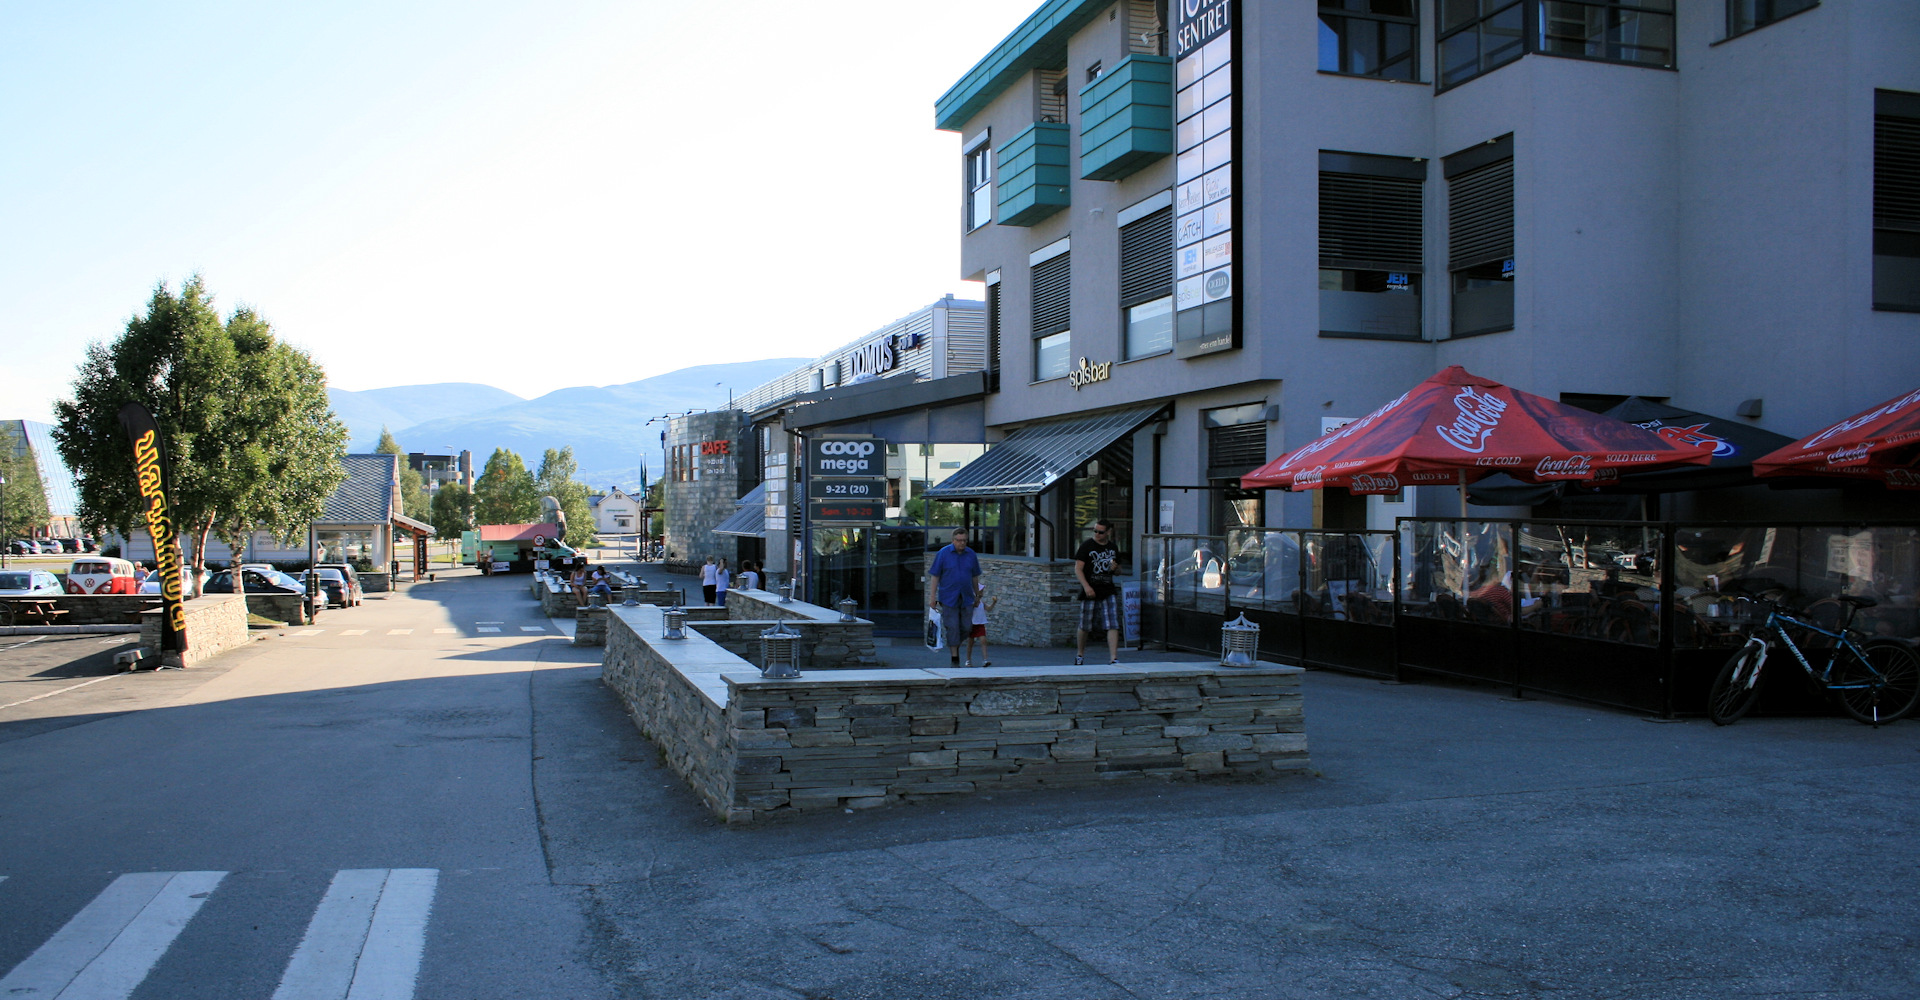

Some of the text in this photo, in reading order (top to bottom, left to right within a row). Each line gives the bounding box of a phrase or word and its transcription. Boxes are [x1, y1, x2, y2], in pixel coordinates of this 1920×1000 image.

[1178, 0, 1230, 55] SENTRET
[1178, 221, 1201, 242] CATCH
[1387, 273, 1408, 284] JEH
[849, 335, 893, 380] DOMUS
[1070, 357, 1111, 391] spisbar
[701, 440, 731, 455] CAFE
[820, 442, 875, 458] coop
[1475, 457, 1522, 466] ICE COLD
[1605, 454, 1657, 463] SOLD HERE
[820, 459, 869, 474] mega
[826, 485, 869, 495] 9-22 (20)
[846, 507, 873, 516] 10-20
